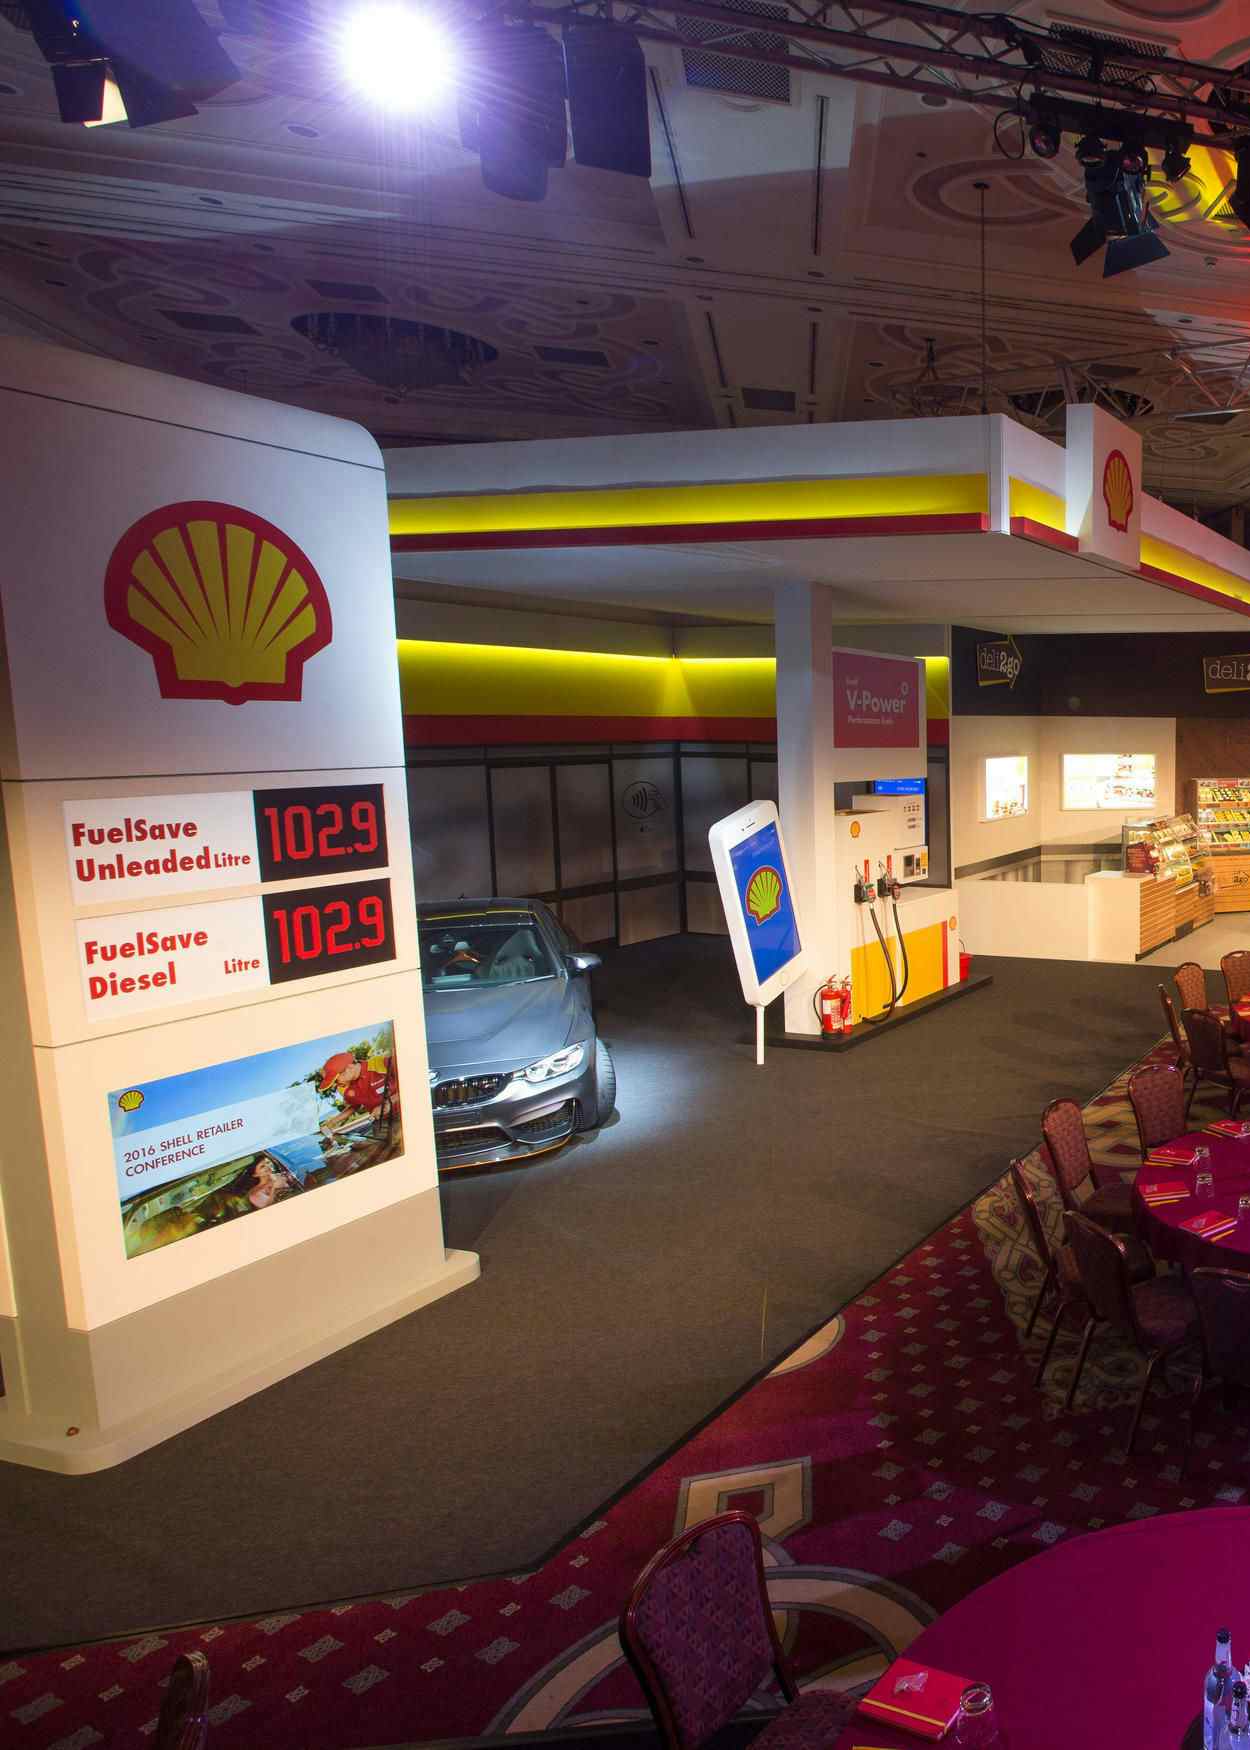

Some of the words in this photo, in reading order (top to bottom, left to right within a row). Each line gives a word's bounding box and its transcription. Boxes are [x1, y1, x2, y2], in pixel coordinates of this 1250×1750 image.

[981, 648, 1020, 678] deli2go
[846, 689, 906, 713] V-Power
[71, 818, 198, 847] FuelSave
[264, 801, 380, 862] 102.9
[76, 846, 211, 882] Unleaded
[214, 852, 251, 869] Litre
[85, 928, 208, 964] FuelSave
[273, 896, 386, 964] 102.9
[89, 962, 176, 1000] Diesel
[224, 957, 260, 975] Litre
[123, 1143, 156, 1164] 2016
[160, 1133, 194, 1153] SHELL
[196, 1117, 245, 1142] RETAILER
[125, 1143, 206, 1178] CONFERENCE
